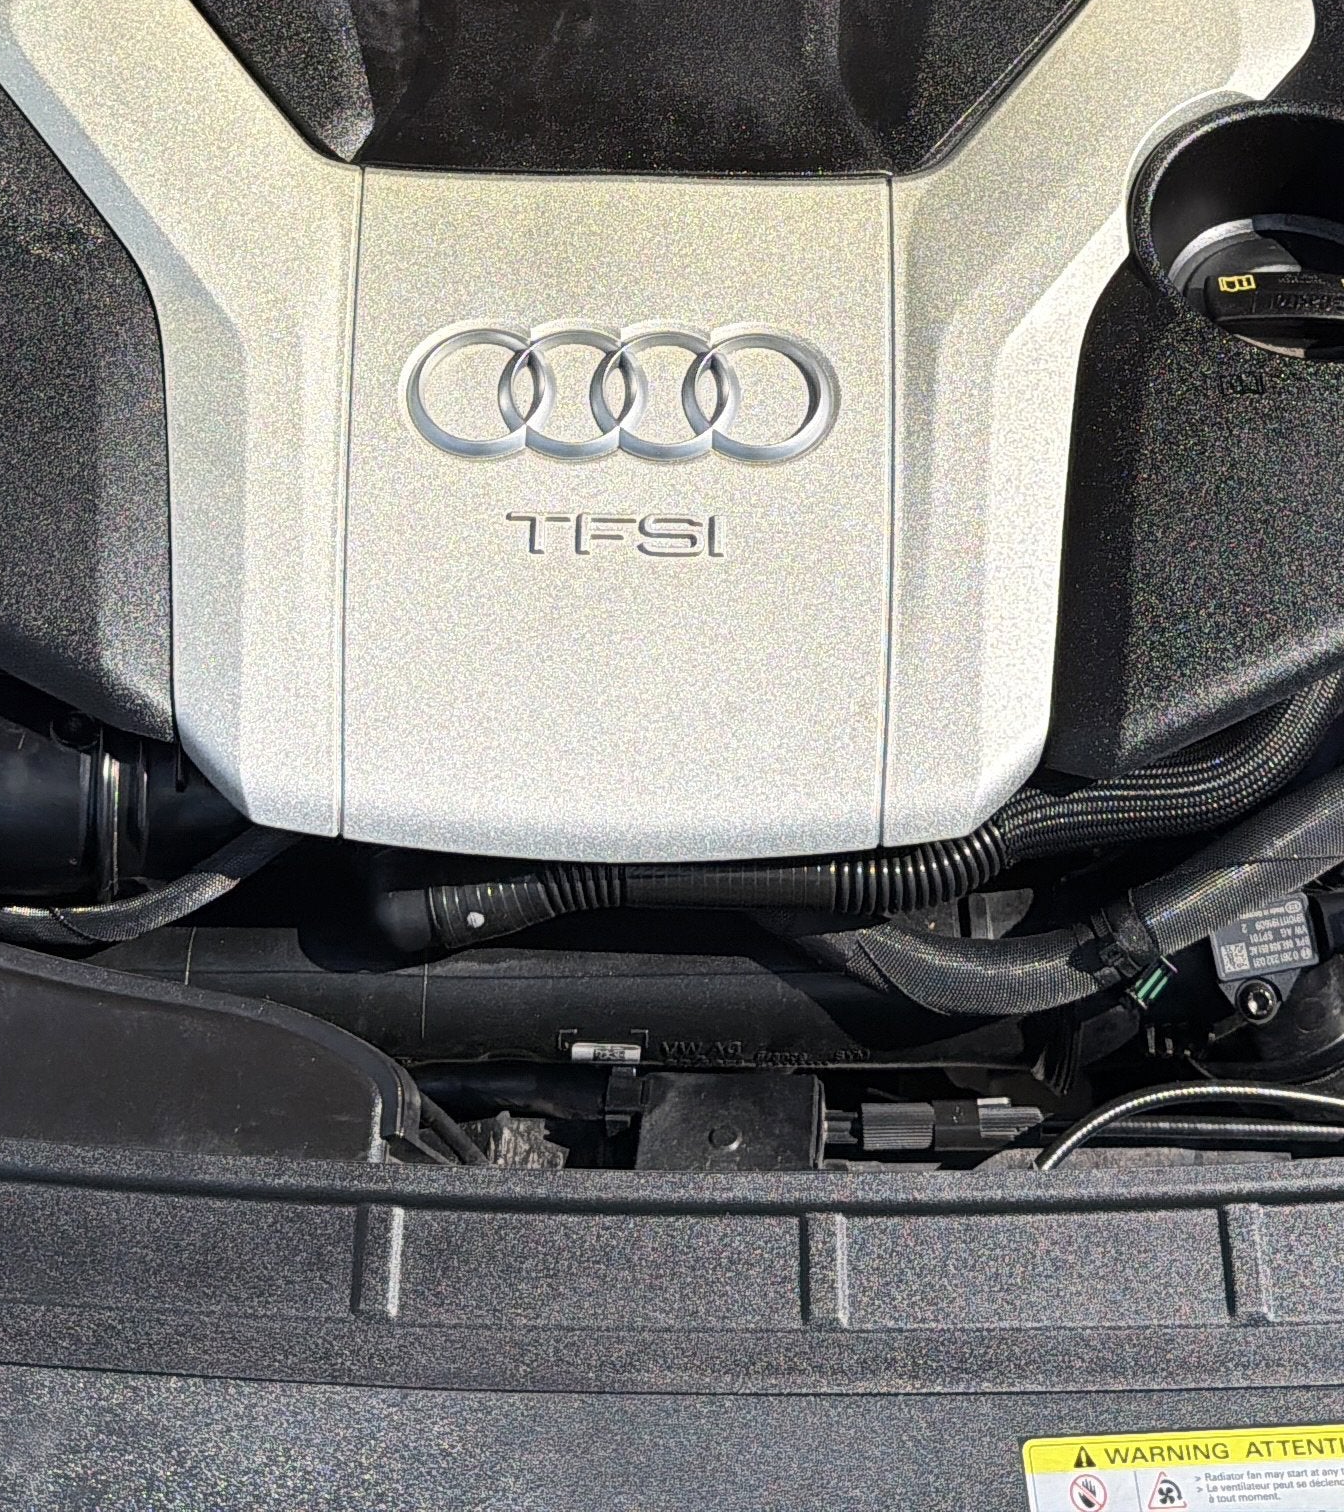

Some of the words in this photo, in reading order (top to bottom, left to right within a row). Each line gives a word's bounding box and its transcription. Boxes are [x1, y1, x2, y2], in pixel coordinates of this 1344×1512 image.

[506, 511, 725, 559] TFSI
[1241, 924, 1247, 933] 2
[1104, 1442, 1229, 1465] WARNING
[1205, 1472, 1244, 1481] Radiator
[1246, 1471, 1263, 1479] fan
[1265, 1471, 1284, 1480] may
[1287, 1468, 1308, 1478] start
[1310, 1468, 1320, 1477] at
[1322, 1468, 1338, 1477] any
[1206, 1483, 1218, 1493] Le
[1220, 1482, 1270, 1492] ventilateur
[1273, 1481, 1294, 1491] peut
[1296, 1480, 1307, 1488] se
[1217, 1494, 1236, 1503] tout
[1238, 1492, 1281, 1502] moment.
